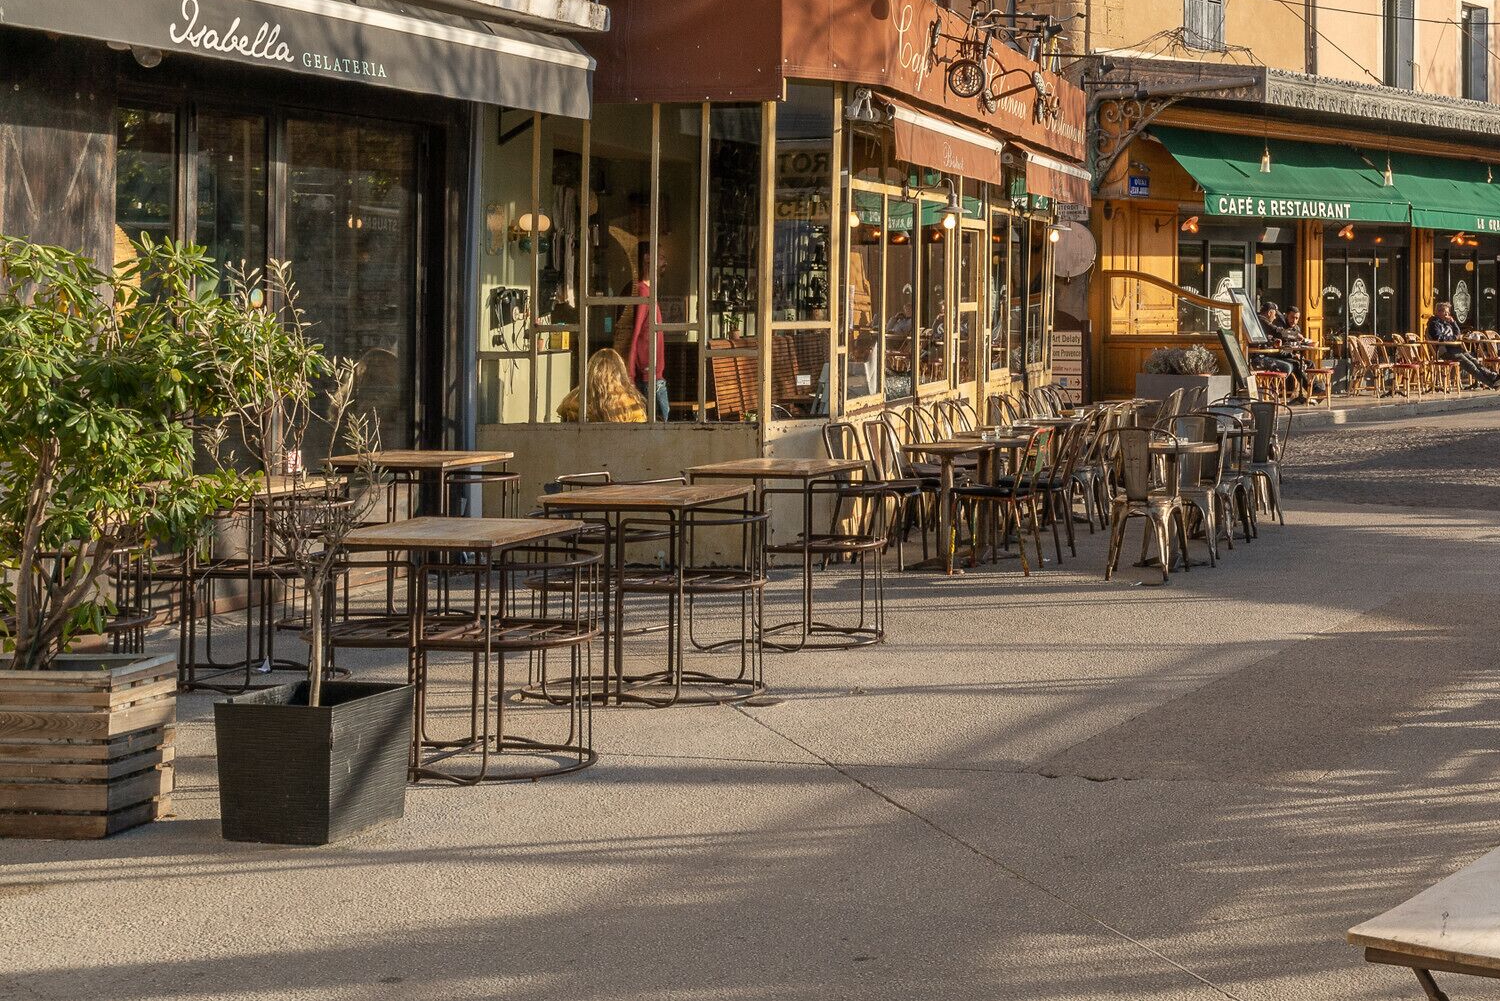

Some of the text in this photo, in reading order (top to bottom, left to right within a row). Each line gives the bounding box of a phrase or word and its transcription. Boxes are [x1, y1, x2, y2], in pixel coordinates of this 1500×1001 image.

[302, 52, 388, 79] GELATERIA
[1219, 197, 1351, 219] CAFÉ & RESTAURANT
[1477, 218, 1485, 230] LE
